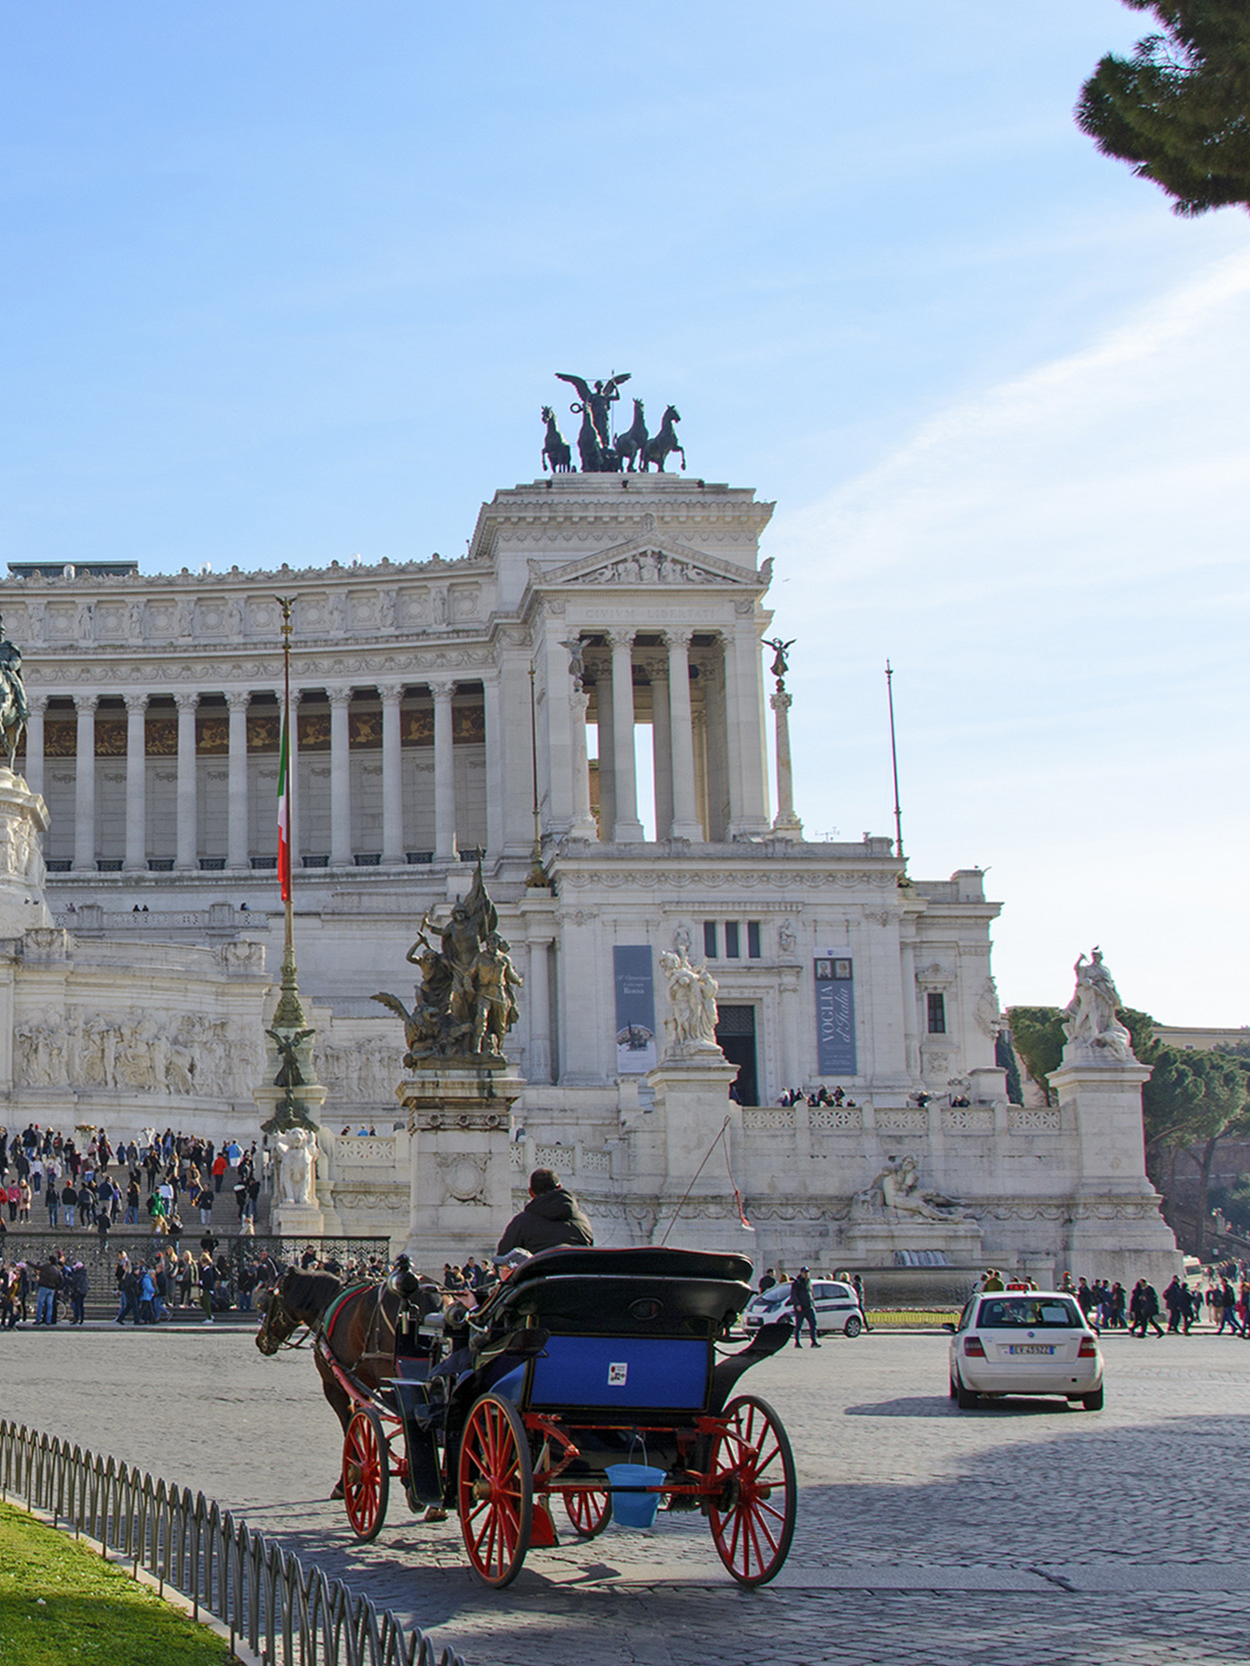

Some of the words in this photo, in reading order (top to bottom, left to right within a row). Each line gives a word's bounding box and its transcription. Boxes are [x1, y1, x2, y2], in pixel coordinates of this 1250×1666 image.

[647, 609, 714, 618] LIBERTATI
[820, 985, 835, 1042] VOGLIA
[833, 987, 851, 1043] d'Italia
